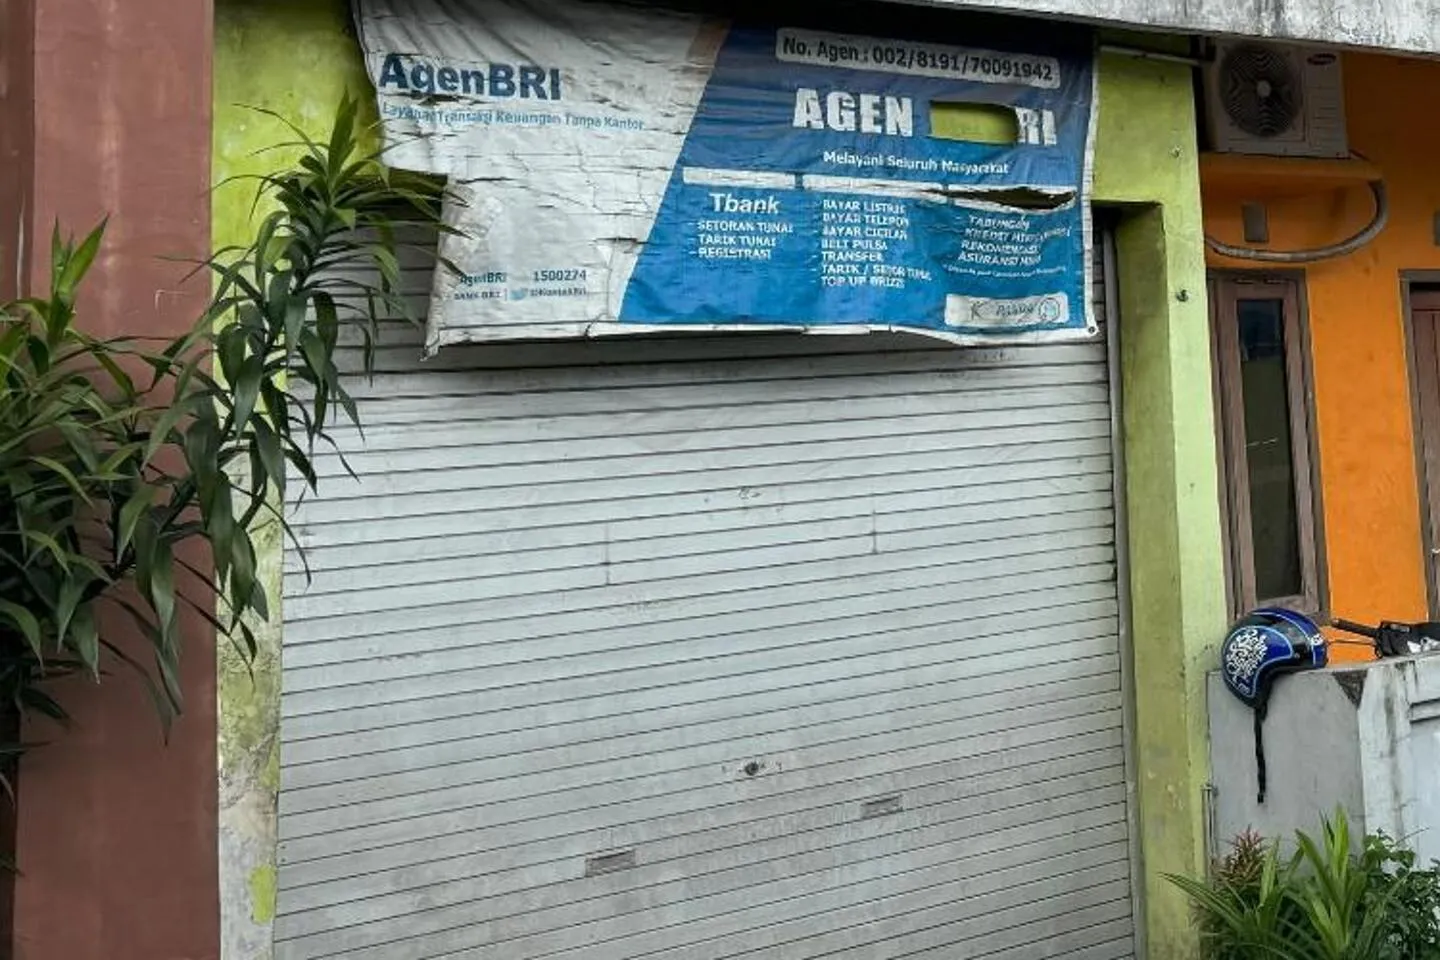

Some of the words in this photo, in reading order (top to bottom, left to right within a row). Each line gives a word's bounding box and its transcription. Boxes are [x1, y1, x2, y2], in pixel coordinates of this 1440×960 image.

[782, 36, 812, 57] No.
[816, 41, 859, 63] Agen
[873, 47, 1054, 81] 002/8191/70091942
[378, 52, 561, 100] AgenBRI
[496, 110, 560, 127] Keuangan
[565, 114, 601, 130] Tanpa
[604, 117, 645, 131] Kantor
[792, 87, 913, 138] AGEN
[1014, 105, 1058, 146] RI
[823, 151, 884, 166] Melayani
[887, 155, 938, 173] Seluruh
[941, 160, 1009, 176] Masyarakat
[708, 193, 780, 214] Tbank
[823, 199, 861, 211] BAYAR
[822, 212, 861, 224] BAYAR
[757, 221, 794, 233] TUNAI
[697, 233, 736, 245] TARIK
[821, 250, 884, 262] TRANSFER
[822, 263, 860, 274] TARIK
[821, 275, 846, 287] TOP
[847, 275, 867, 287] UP
